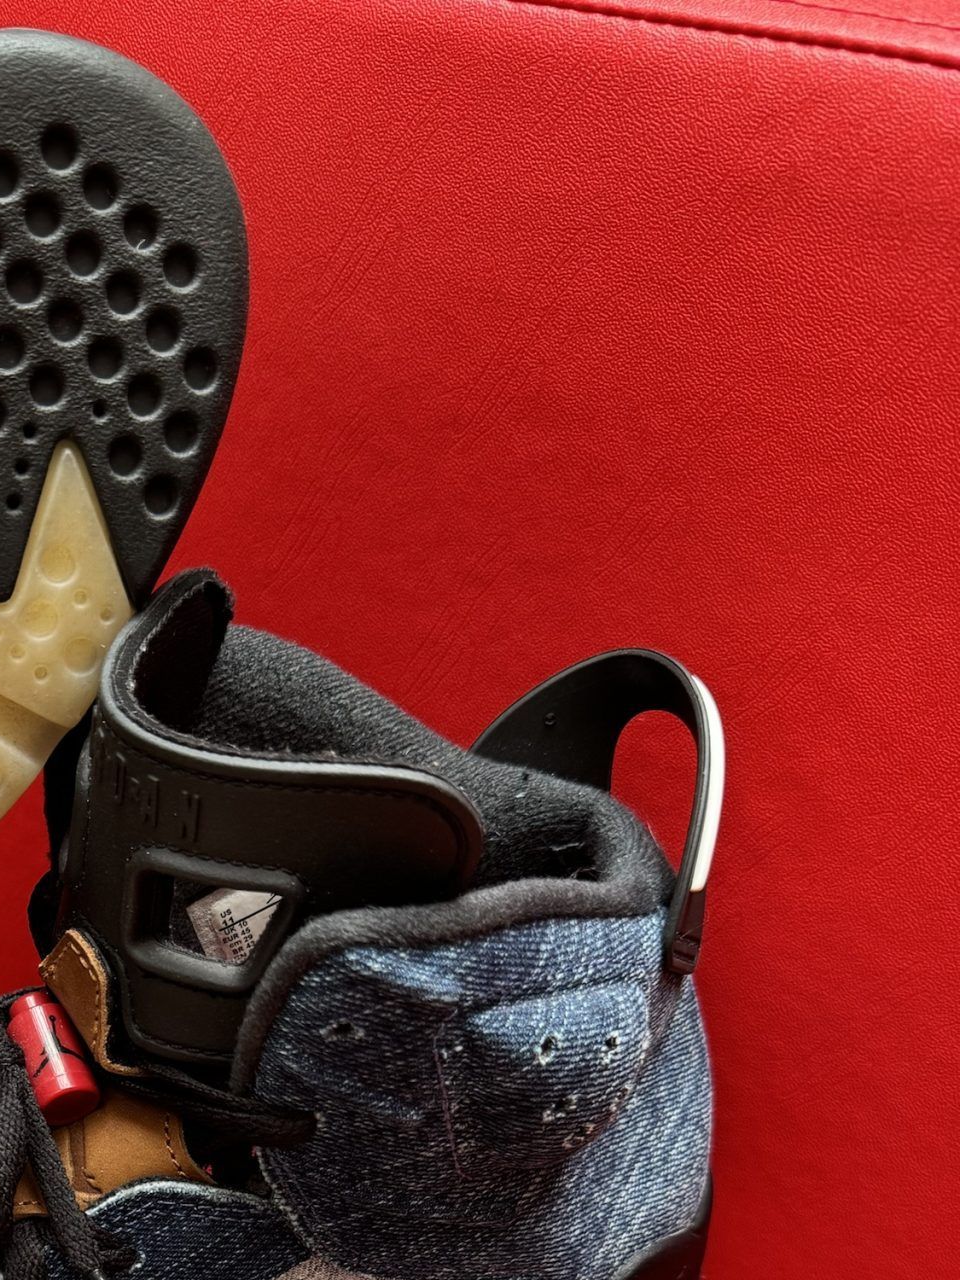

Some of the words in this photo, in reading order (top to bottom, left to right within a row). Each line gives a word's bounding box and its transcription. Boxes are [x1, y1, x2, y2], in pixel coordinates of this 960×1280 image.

[220, 908, 232, 919] US
[222, 916, 235, 927] 11
[224, 926, 236, 936] UK
[238, 920, 248, 928] 10
[222, 933, 239, 944] EUR
[241, 927, 251, 936] 45
[243, 934, 253, 943] 29
